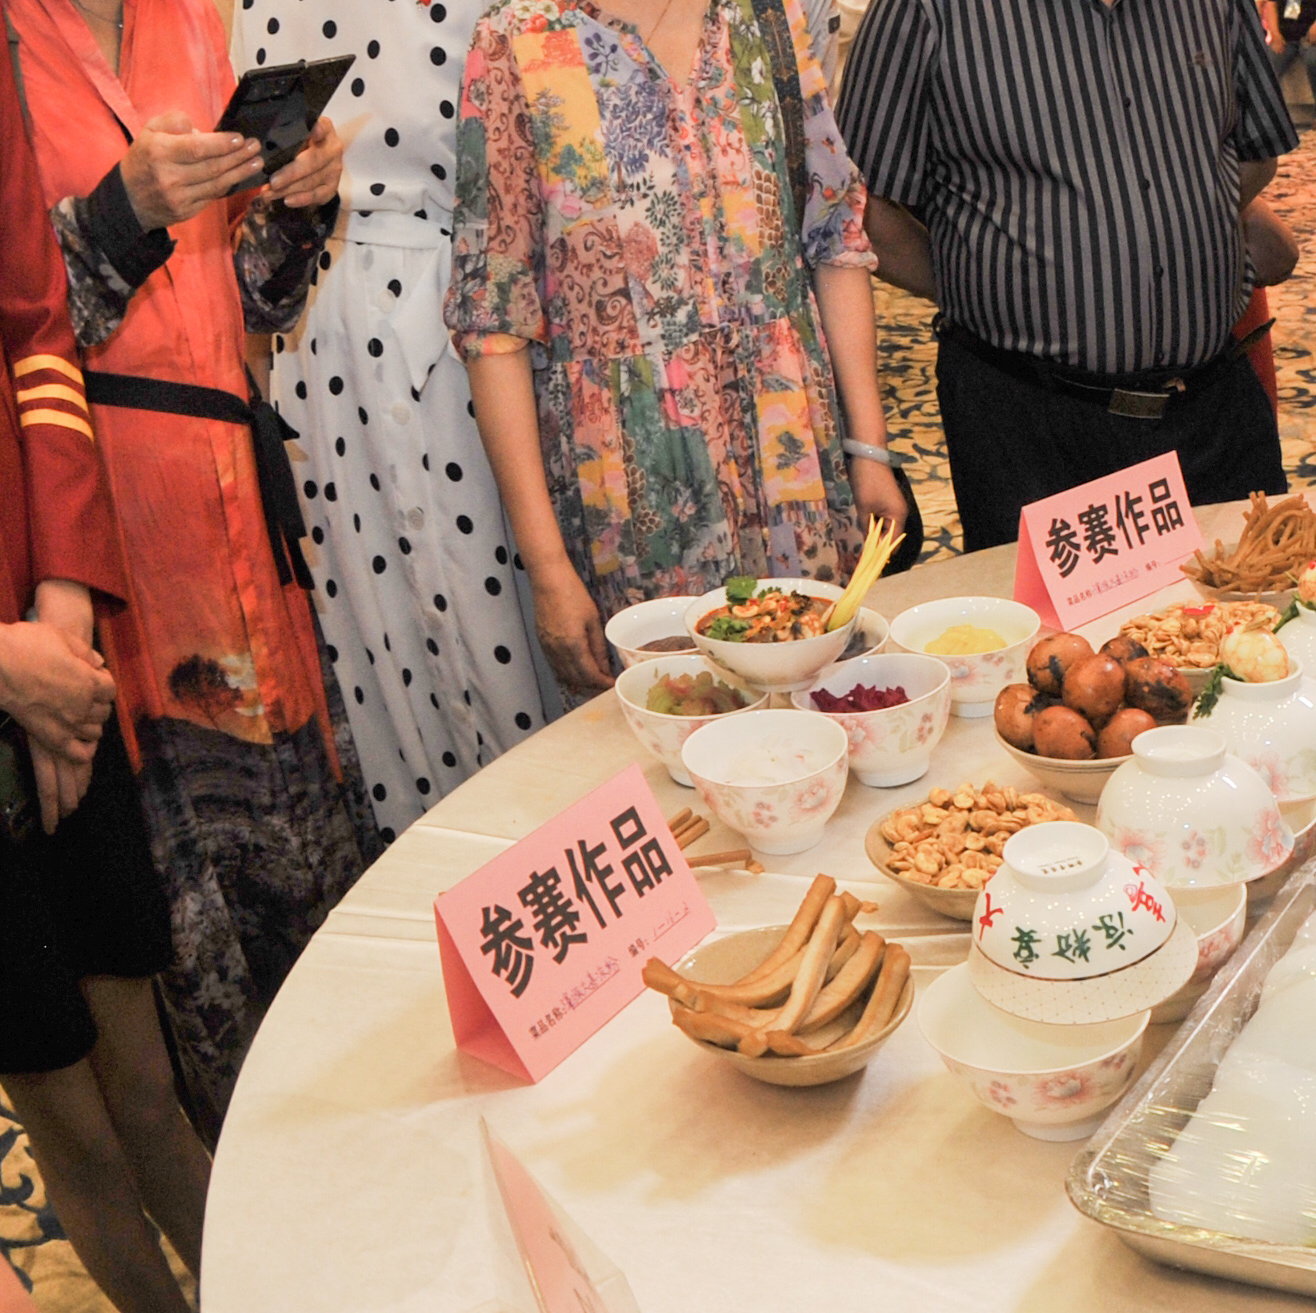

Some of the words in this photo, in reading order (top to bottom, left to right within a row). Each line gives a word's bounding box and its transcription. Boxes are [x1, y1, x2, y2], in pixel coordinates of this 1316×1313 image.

[1046, 477, 1185, 579] 参赛作品
[480, 805, 674, 1000] 参赛作品
